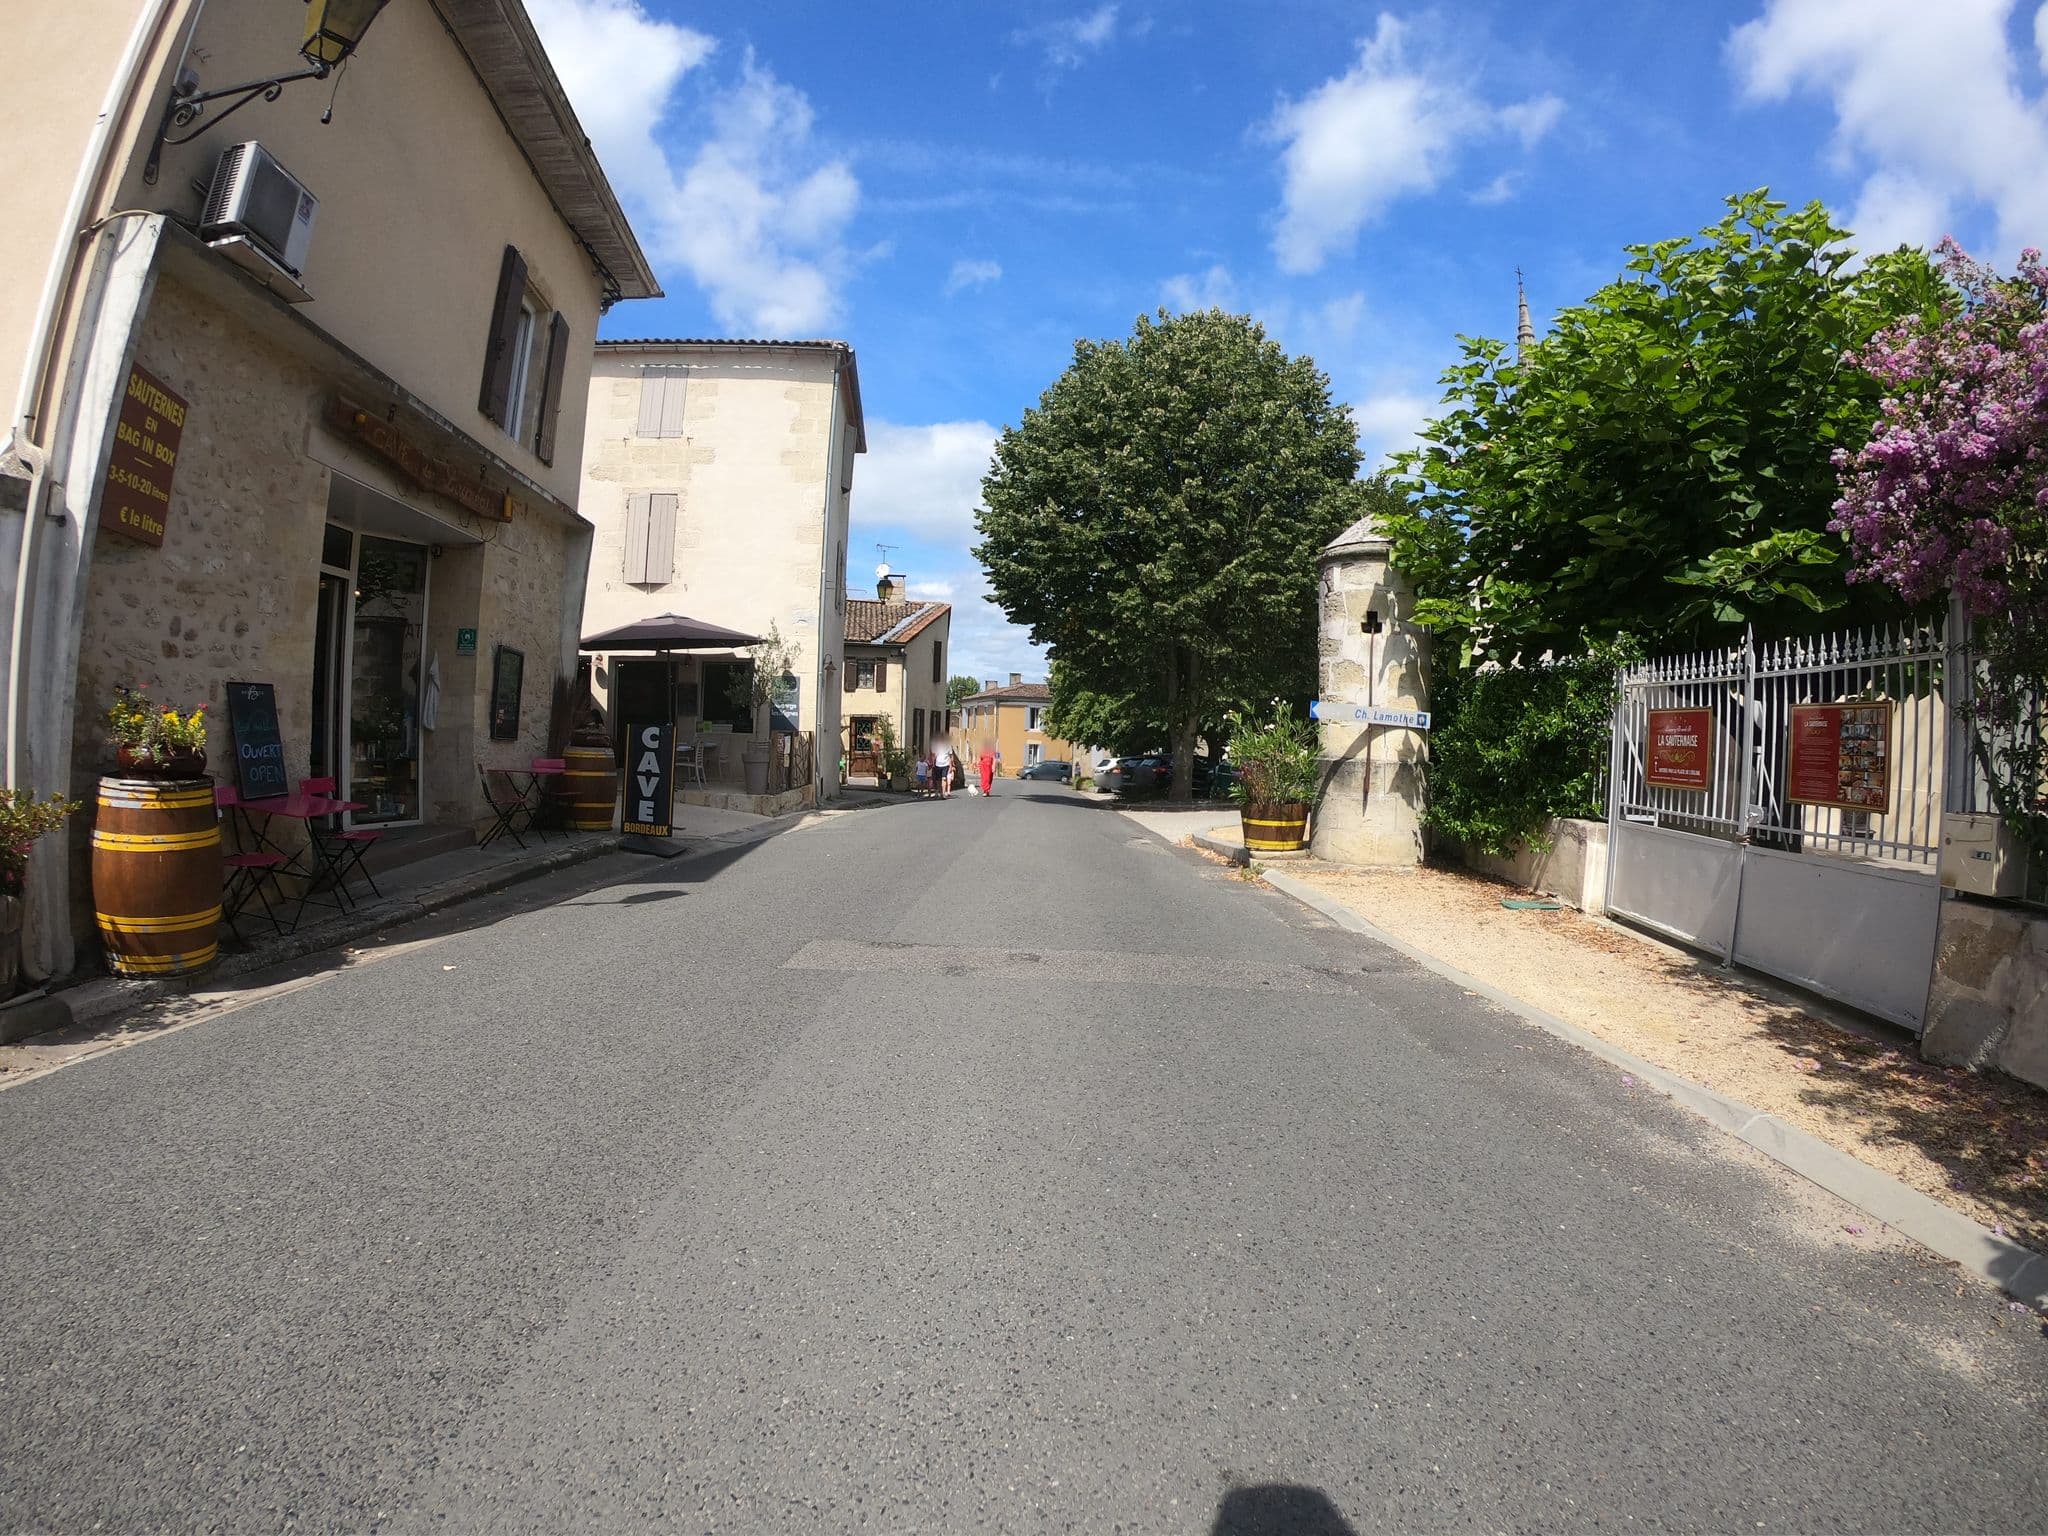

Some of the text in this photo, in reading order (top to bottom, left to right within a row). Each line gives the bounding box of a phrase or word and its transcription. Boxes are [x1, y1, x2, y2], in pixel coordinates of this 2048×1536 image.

[128, 373, 185, 428] SAUTERNES
[145, 416, 158, 433] EN
[117, 421, 176, 466] BAG IN BOX
[108, 464, 169, 503] 3-5-10-20 litres
[120, 506, 163, 536] € le litre
[1354, 708, 1414, 724] Ch. Lamothe
[1657, 735, 1698, 747] LA SAUTERNAISE
[241, 743, 282, 759] OUVERT
[249, 765, 284, 783] OPEN
[637, 726, 660, 823] CAVE
[623, 822, 669, 836] BORDEAUX
